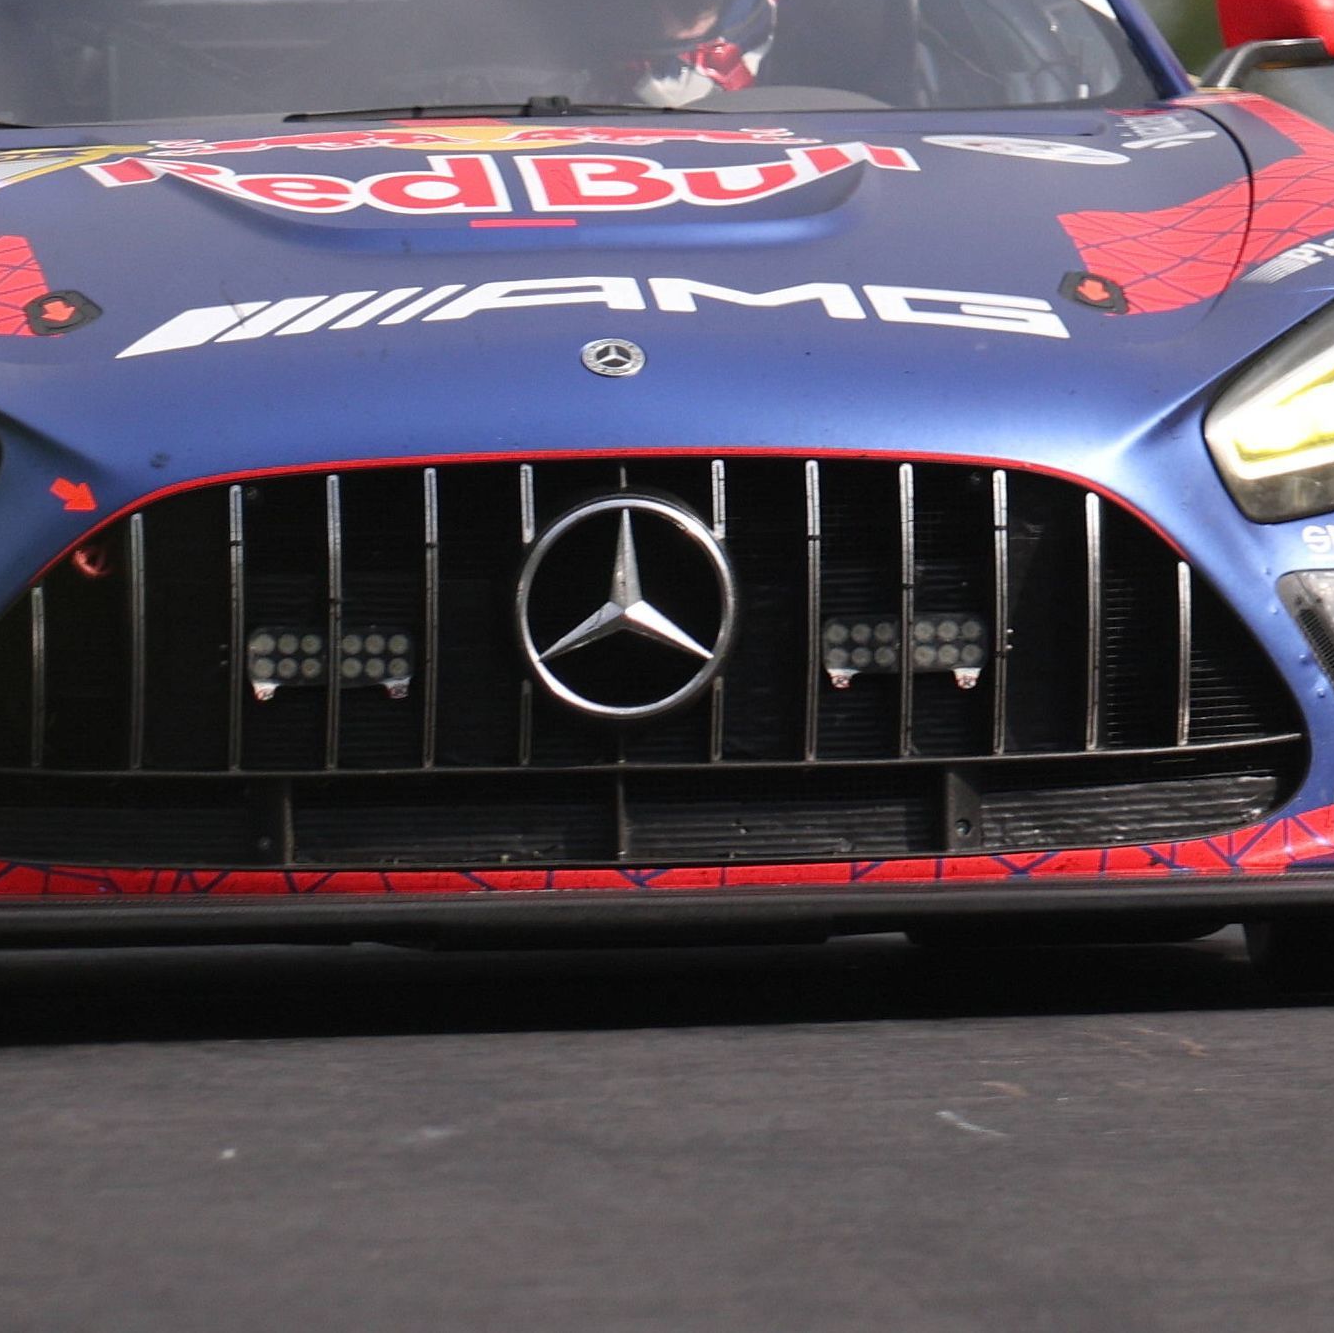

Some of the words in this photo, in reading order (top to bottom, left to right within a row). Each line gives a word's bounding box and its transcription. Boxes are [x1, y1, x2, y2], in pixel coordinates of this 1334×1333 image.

[81, 153, 513, 214] Red
[515, 141, 921, 212] Bull
[423, 276, 1070, 339] AMG
